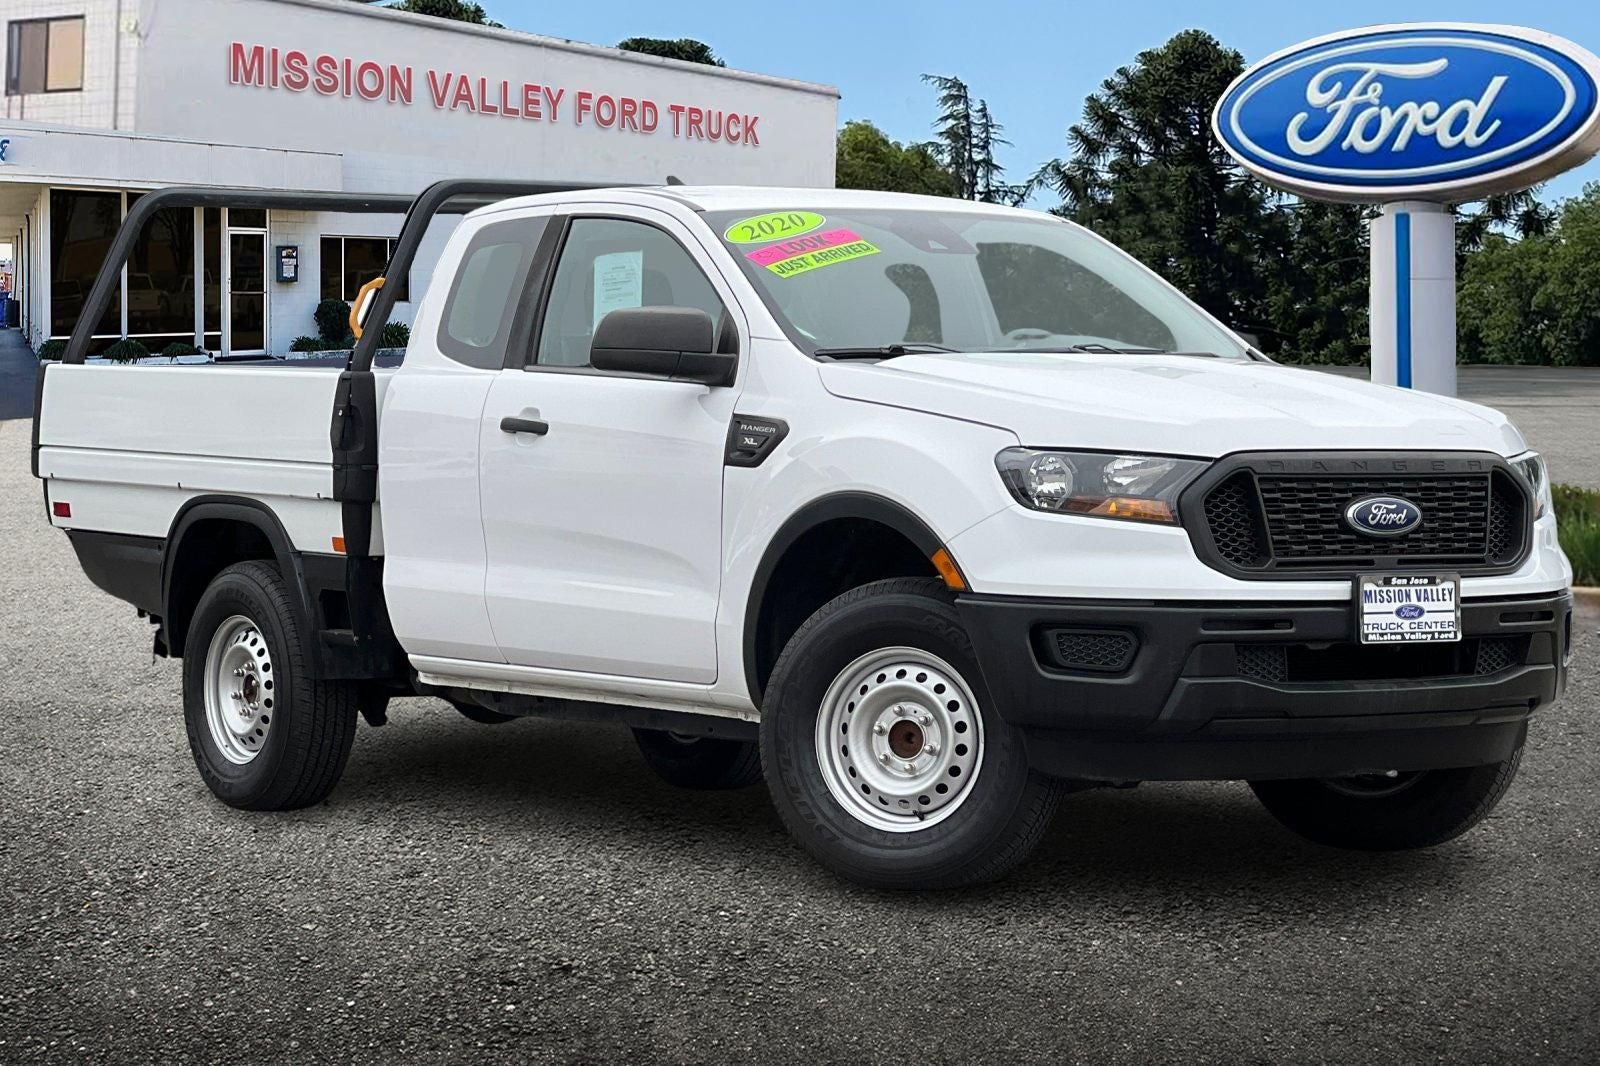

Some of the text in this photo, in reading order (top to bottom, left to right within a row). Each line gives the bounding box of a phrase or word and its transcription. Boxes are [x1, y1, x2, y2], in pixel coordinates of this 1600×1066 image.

[230, 41, 760, 146] MISSION VALLEY FORD TRUCK
[1286, 57, 1509, 156] Ford
[741, 213, 806, 240] 2020
[776, 234, 830, 255] LOOK
[776, 242, 871, 275] JUST ARRIVED
[740, 424, 776, 433] RANGER
[743, 437, 758, 446] XL
[1267, 459, 1484, 472] RANGER
[1367, 503, 1408, 525] Ford
[1390, 577, 1408, 585] San
[1364, 587, 1454, 604] MISSION VALLEY
[1400, 606, 1420, 618] Ford
[1364, 620, 1456, 631] TRUCK CENTER
[1403, 631, 1433, 641] Valley
